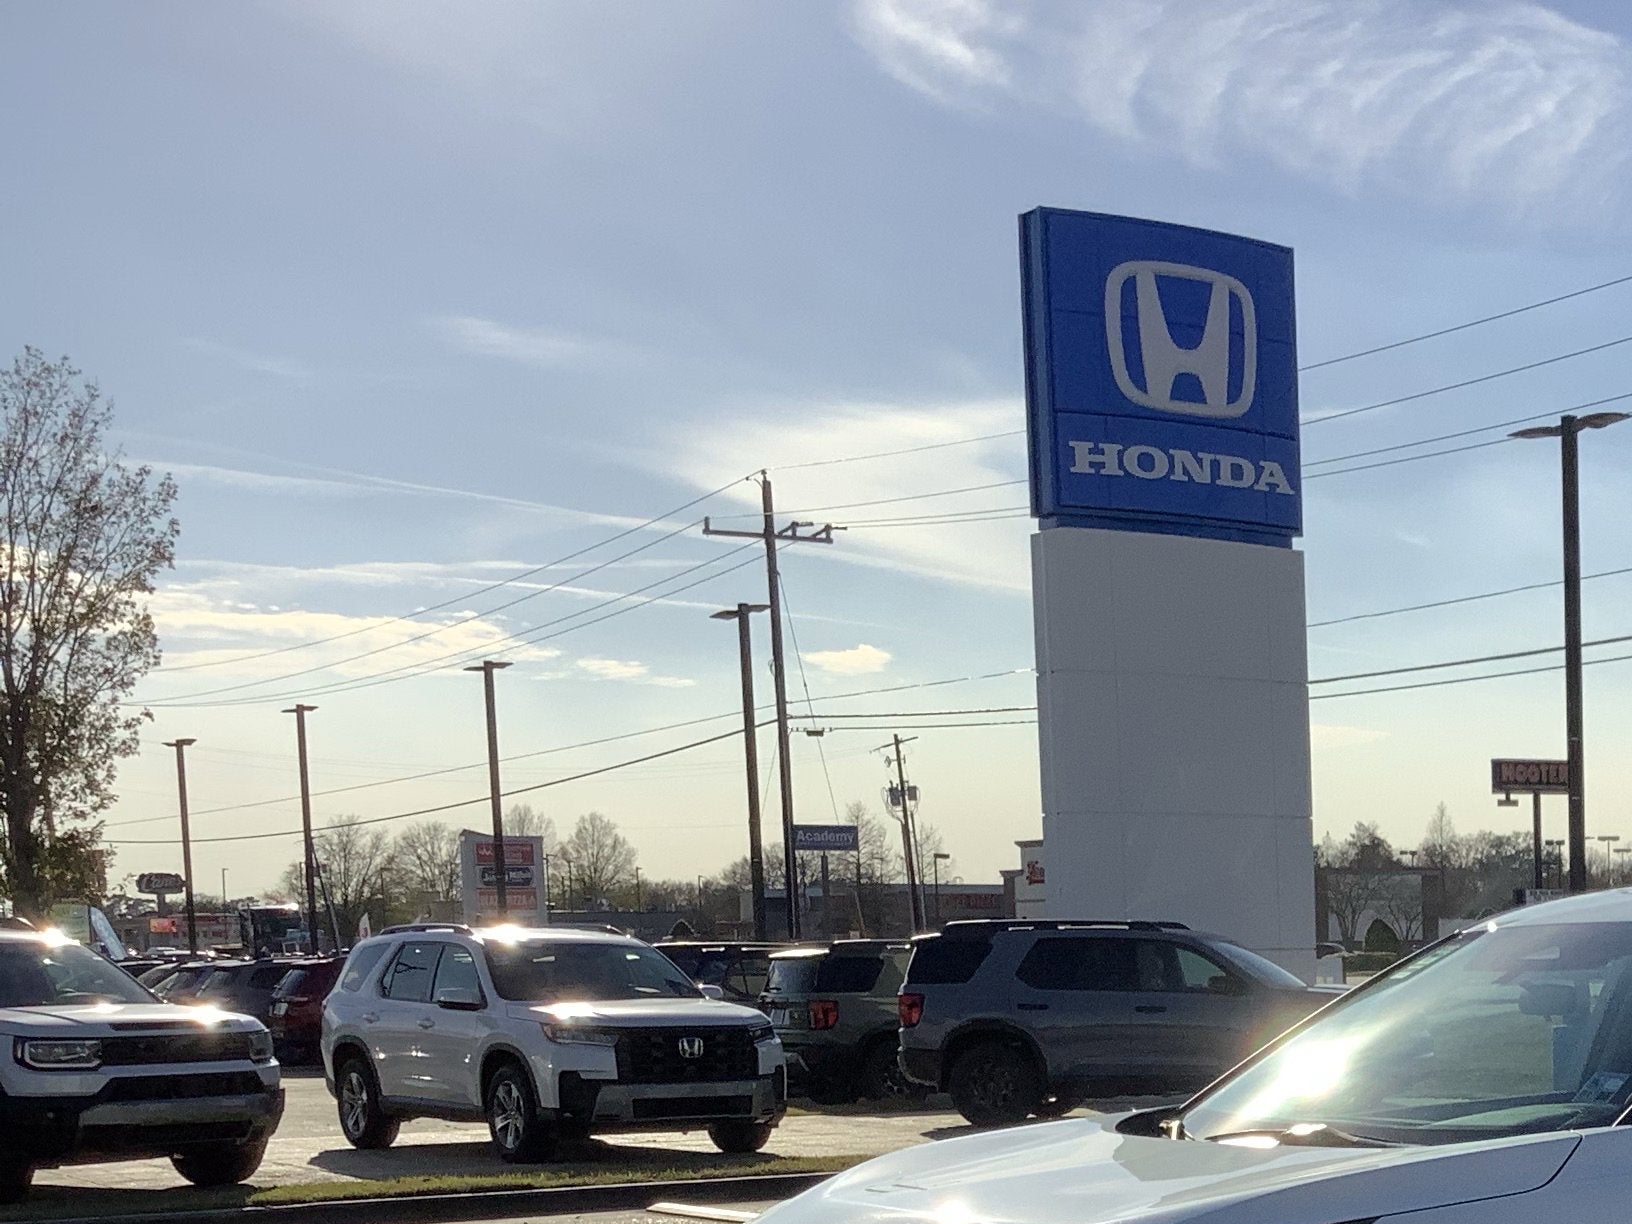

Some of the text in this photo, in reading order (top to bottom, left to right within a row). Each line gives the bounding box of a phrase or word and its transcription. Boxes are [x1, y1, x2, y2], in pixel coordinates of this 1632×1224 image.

[1068, 440, 1296, 495] HONDA
[1501, 762, 1569, 783] HOOTER
[797, 830, 853, 845] Academy
